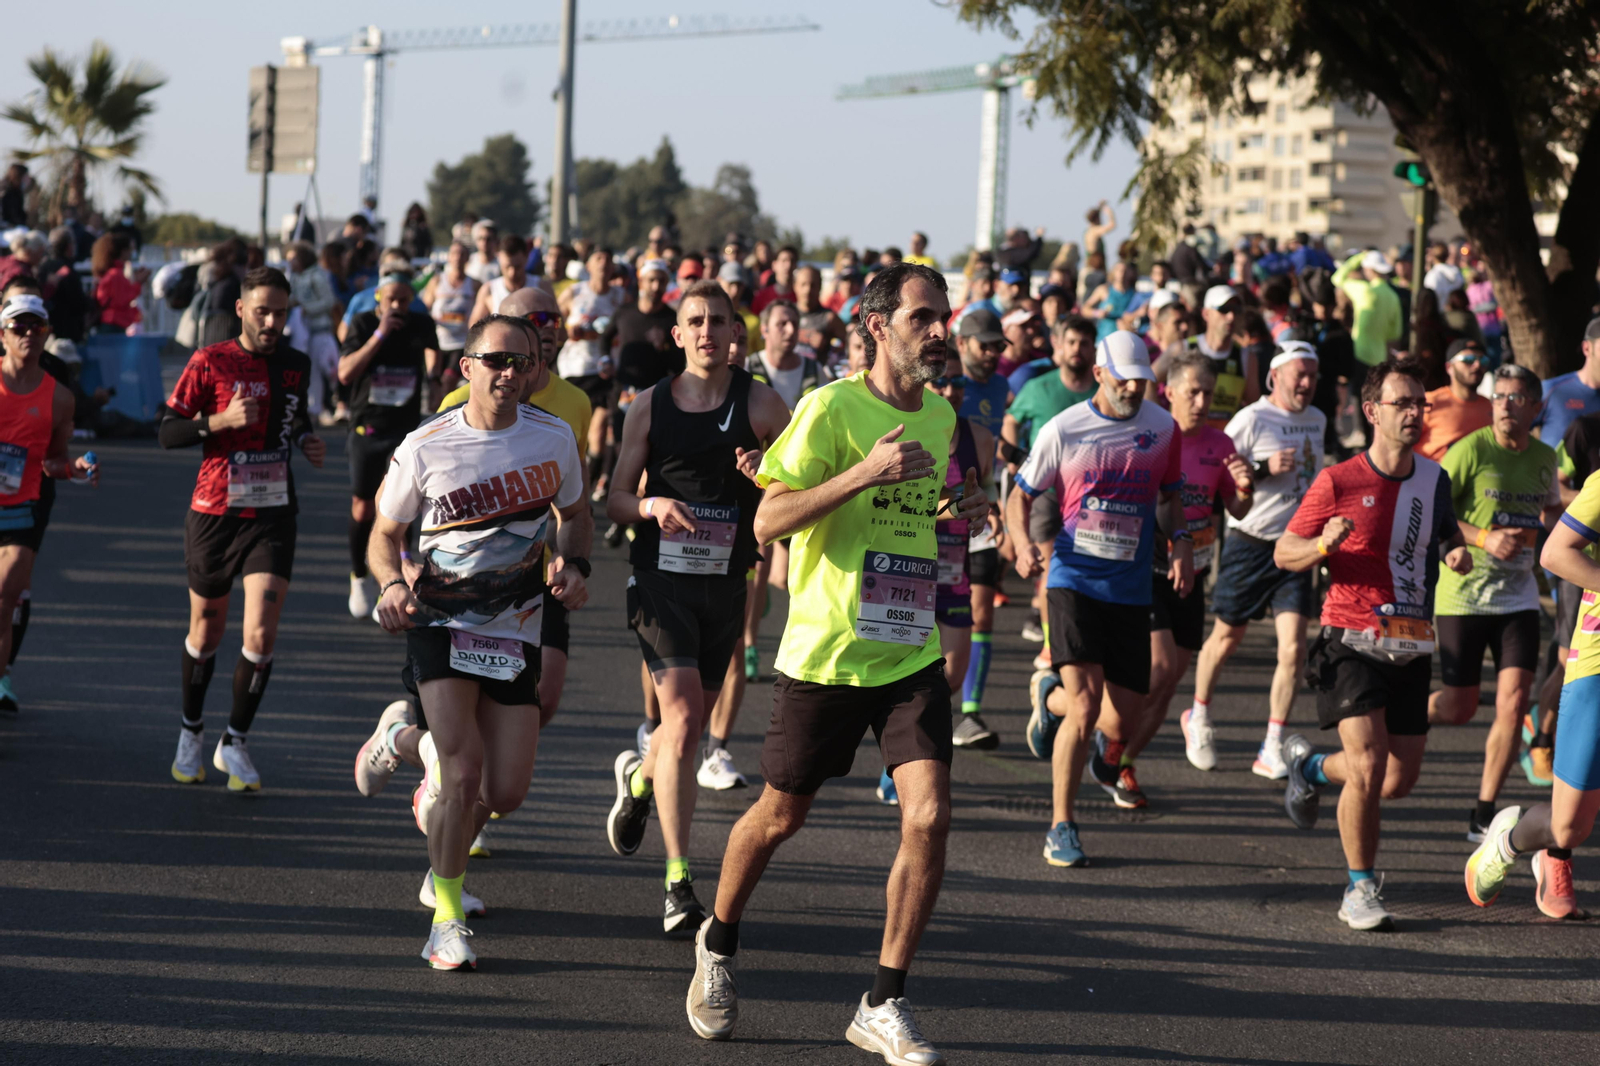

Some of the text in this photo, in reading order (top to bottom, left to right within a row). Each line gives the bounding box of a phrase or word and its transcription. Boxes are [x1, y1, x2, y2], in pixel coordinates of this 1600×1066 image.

[249, 452, 281, 462] ZURICH
[1485, 488, 1512, 502] PACO
[1101, 500, 1138, 514] ZURICH
[871, 518, 910, 528] RUNNING
[686, 529, 711, 541] 7172
[894, 530, 917, 538] OSSOS
[1077, 531, 1102, 543] ISMAEL
[1395, 497, 1423, 572] Stezzano
[682, 546, 711, 557] NACHO
[893, 560, 932, 575] ZURICH
[891, 586, 916, 602] 7121
[887, 608, 915, 622] OSSOS
[1397, 605, 1424, 616] ZURICH
[472, 639, 499, 650] 7560
[458, 651, 508, 665] DAVID
